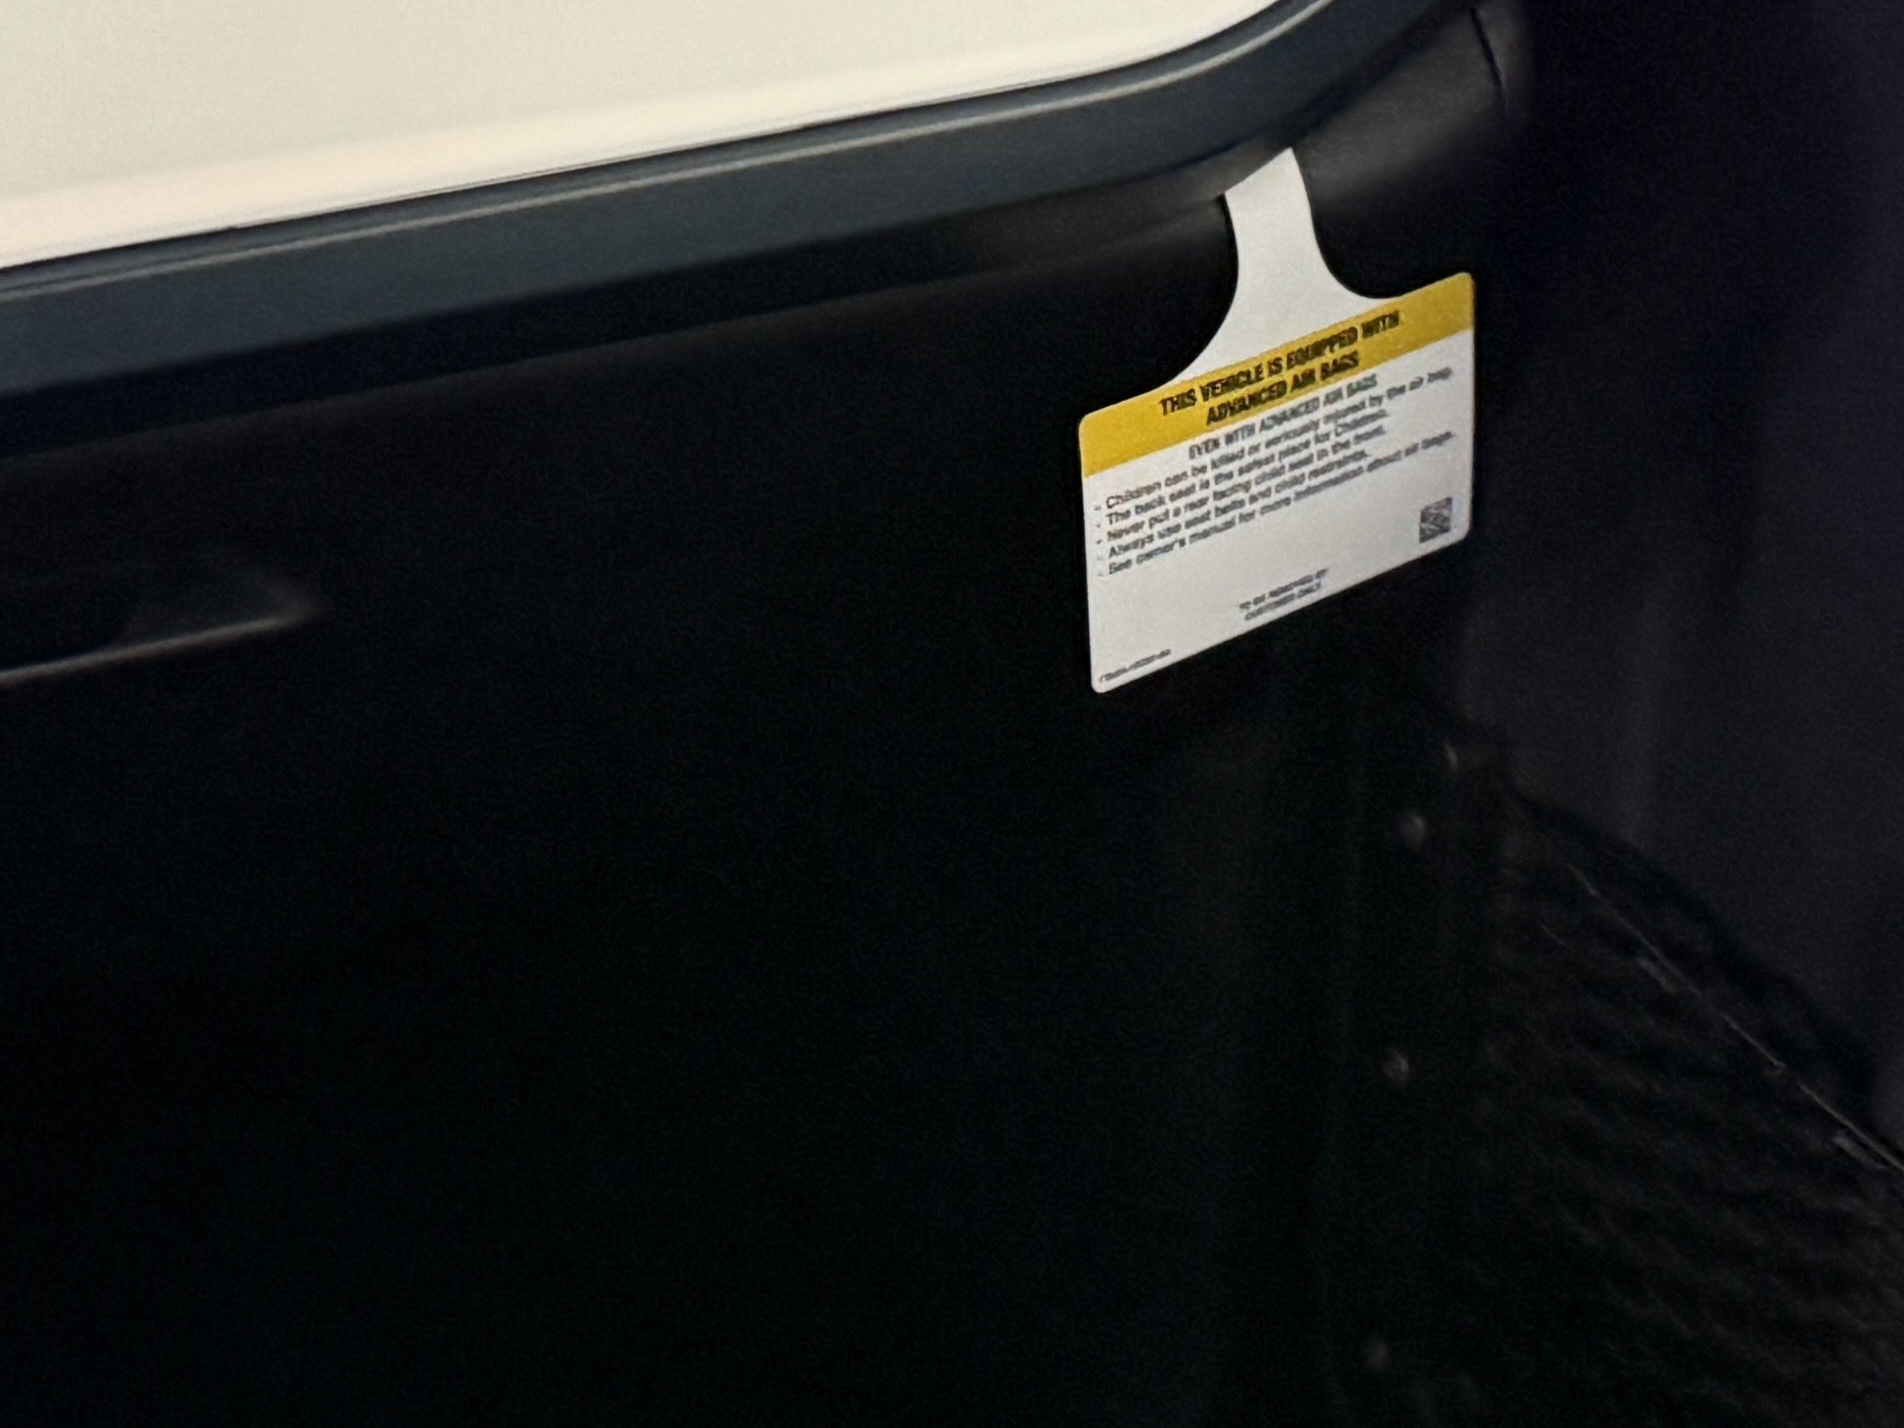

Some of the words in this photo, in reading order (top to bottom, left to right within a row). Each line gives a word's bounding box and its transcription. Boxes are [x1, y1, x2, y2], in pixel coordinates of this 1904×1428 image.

[1159, 388, 1198, 416] THIS
[1199, 363, 1264, 403] VEHICLE
[1267, 356, 1285, 377] IS
[1286, 326, 1358, 370] EQUIPPED
[1361, 309, 1400, 339] WITH
[1206, 379, 1288, 425] ADVANCED
[1290, 367, 1317, 392] AIR
[1319, 350, 1360, 380] BAGS
[1188, 437, 1220, 460] EVEN
[1224, 423, 1256, 445] WITH
[1259, 396, 1321, 433] ADVANCED
[1346, 373, 1379, 398] BAGS
[1105, 509, 1132, 525] The
[1134, 496, 1166, 516] back
[1168, 483, 1196, 503] seat
[1214, 471, 1235, 485] the
[1106, 481, 1162, 510] Children
[1165, 471, 1189, 487] can
[1107, 521, 1146, 542] Never
[1108, 534, 1155, 559] Always
[1248, 486, 1273, 504] and
[1108, 558, 1133, 575] See
